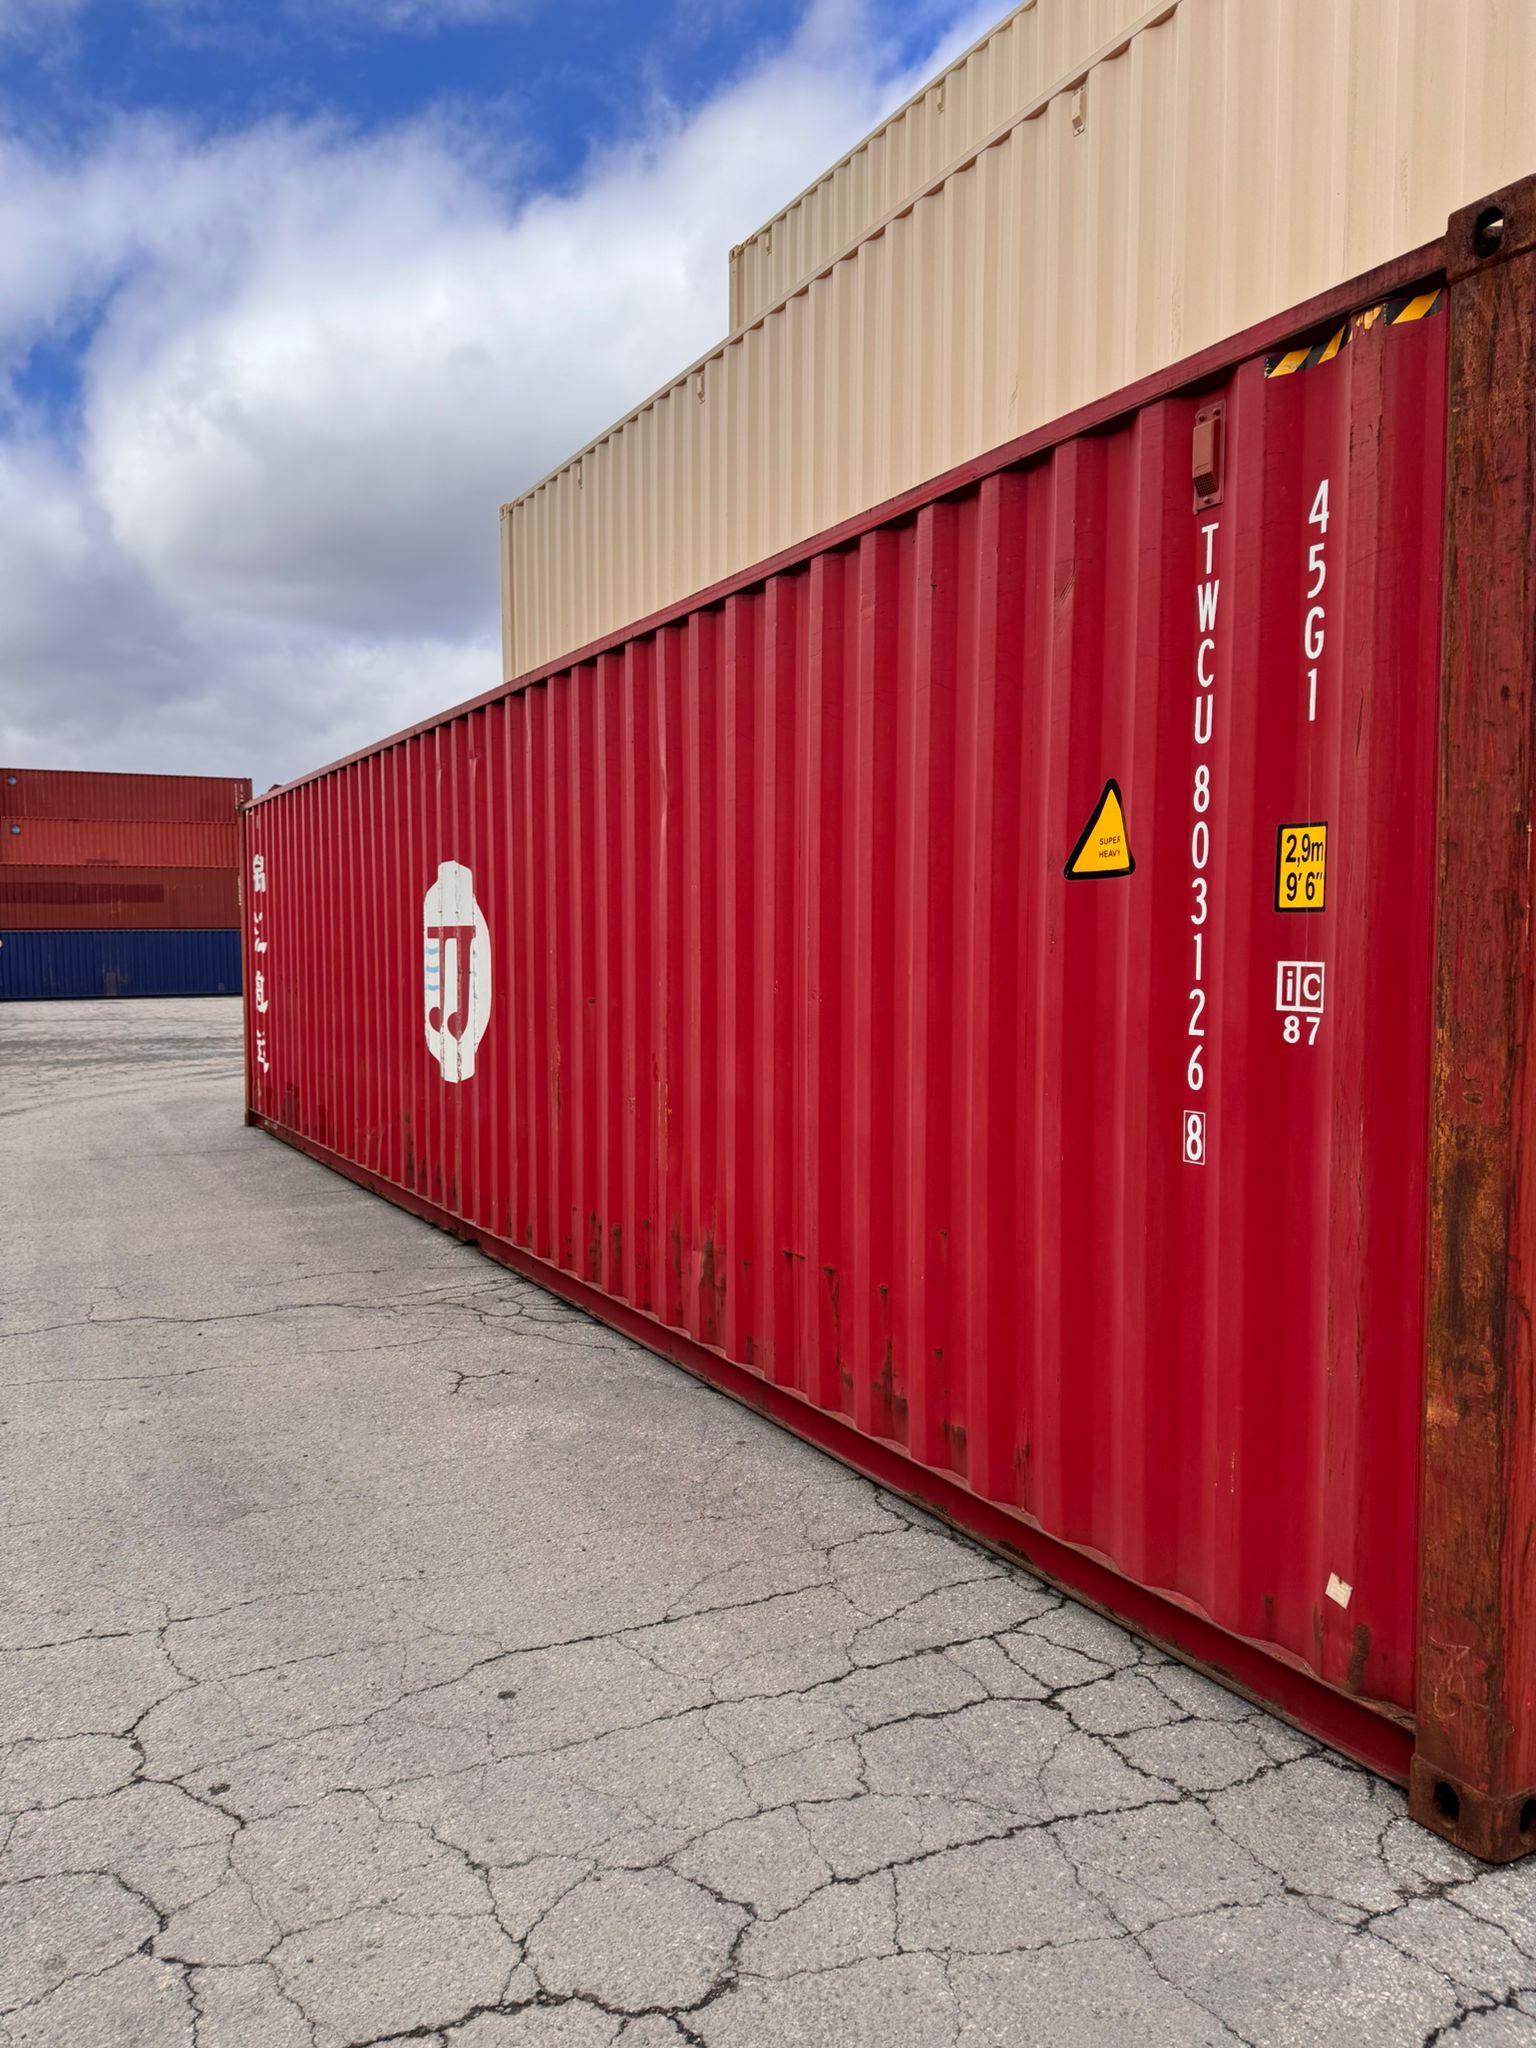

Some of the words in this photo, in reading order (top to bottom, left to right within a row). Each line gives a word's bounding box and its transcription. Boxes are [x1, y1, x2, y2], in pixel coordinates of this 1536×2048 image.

[1194, 522, 1220, 745] TWCU
[1304, 478, 1330, 721] 45G1
[1285, 833, 1324, 868] 2,9m
[1187, 764, 1210, 1091] 803126
[1282, 1015, 1321, 1046] 87
[1186, 1114, 1203, 1161] 8
